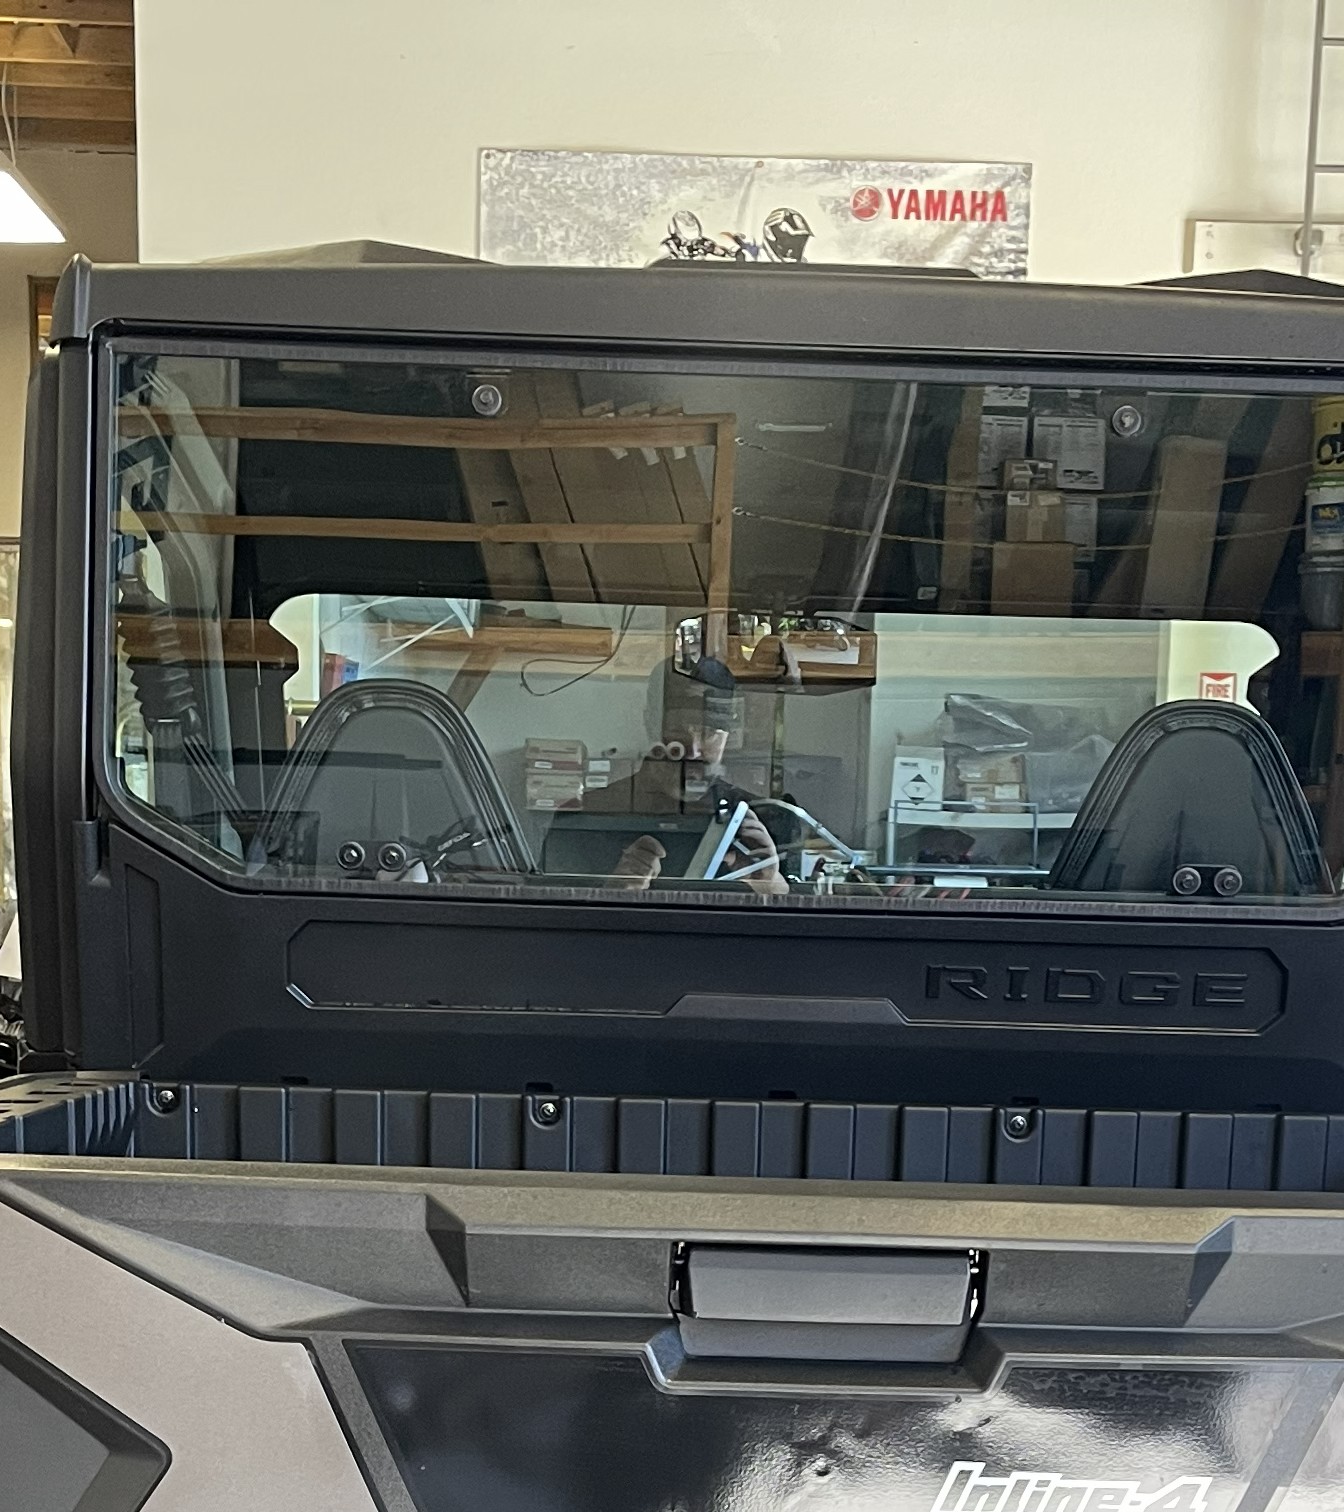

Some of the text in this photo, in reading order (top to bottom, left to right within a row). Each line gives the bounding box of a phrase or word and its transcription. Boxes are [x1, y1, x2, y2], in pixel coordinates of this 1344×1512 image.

[886, 188, 1008, 222] YAMAHA
[1205, 683, 1231, 699] FIRE
[924, 964, 1249, 1006] RIDGE
